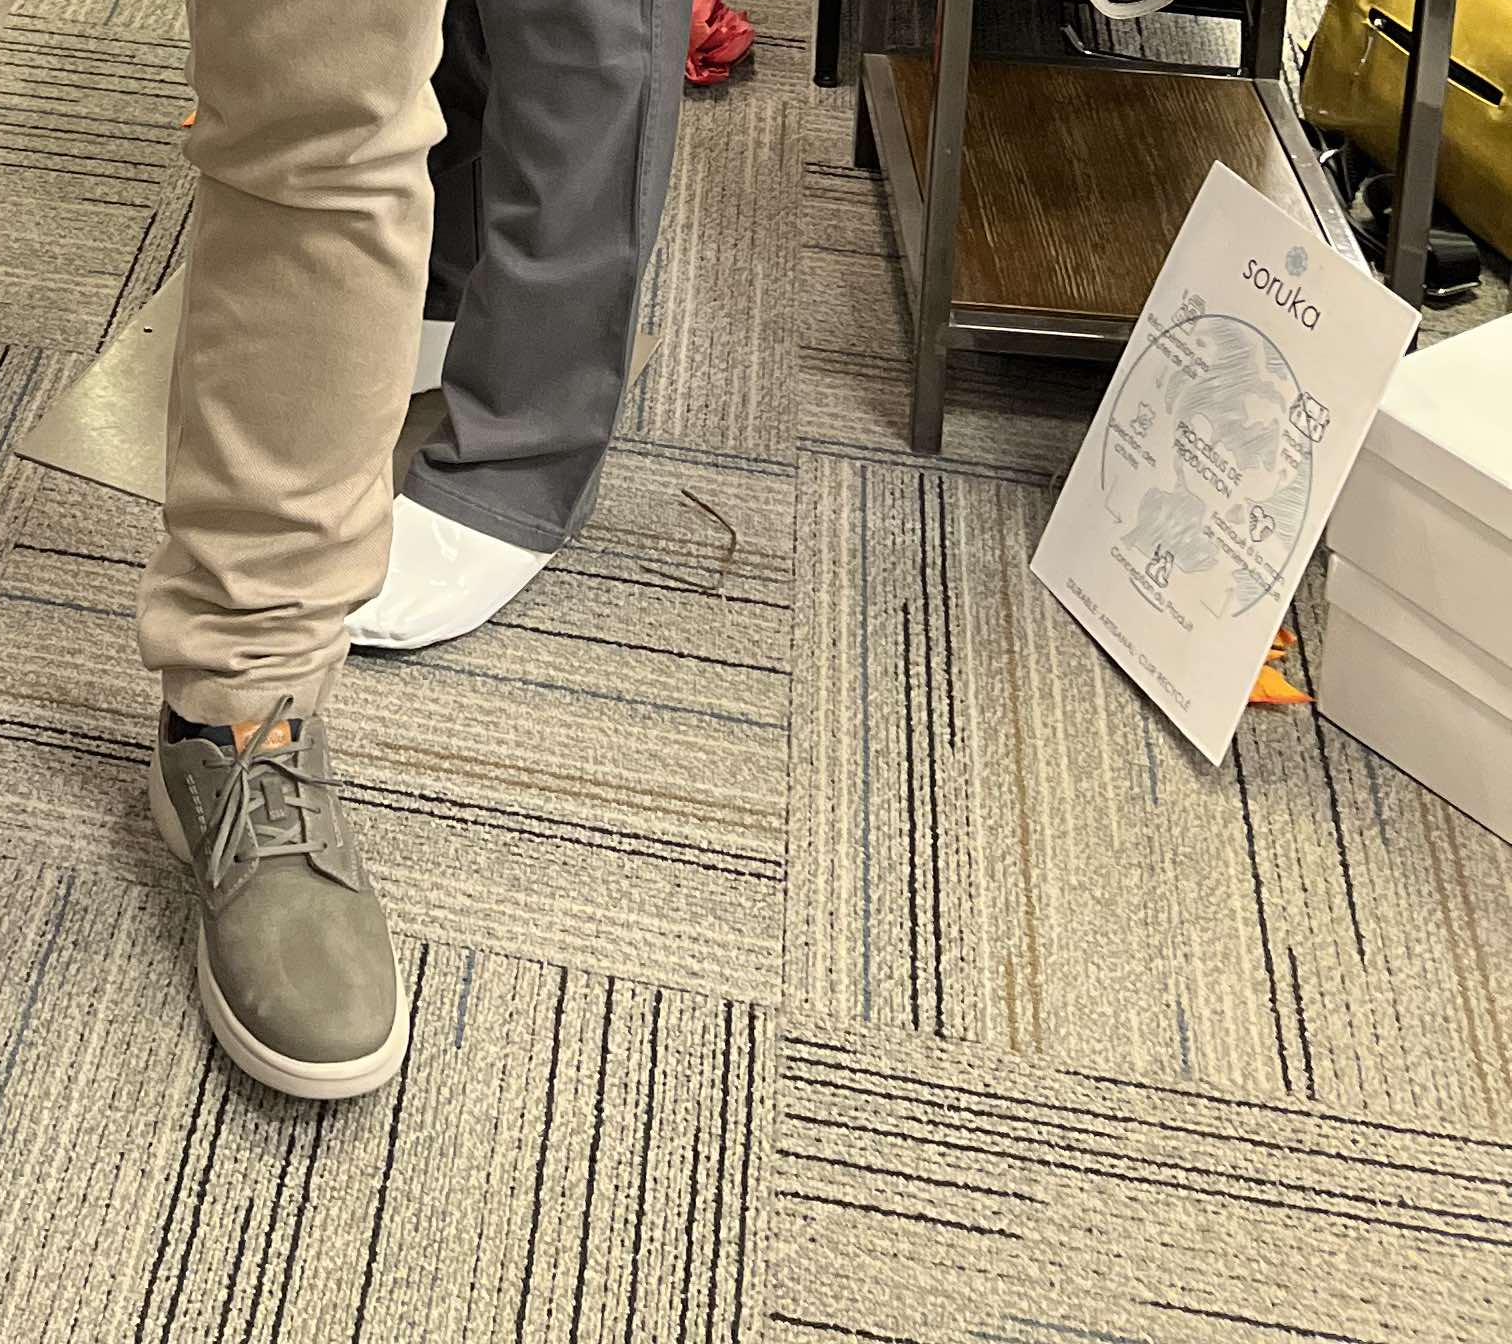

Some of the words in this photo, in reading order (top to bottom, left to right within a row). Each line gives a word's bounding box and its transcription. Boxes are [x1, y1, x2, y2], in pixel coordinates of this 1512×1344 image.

[1242, 258, 1321, 331] soruka
[1172, 437, 1233, 499] PRODUCTION
[1175, 420, 1229, 474] PROCESSUS
[1226, 466, 1244, 487] DE
